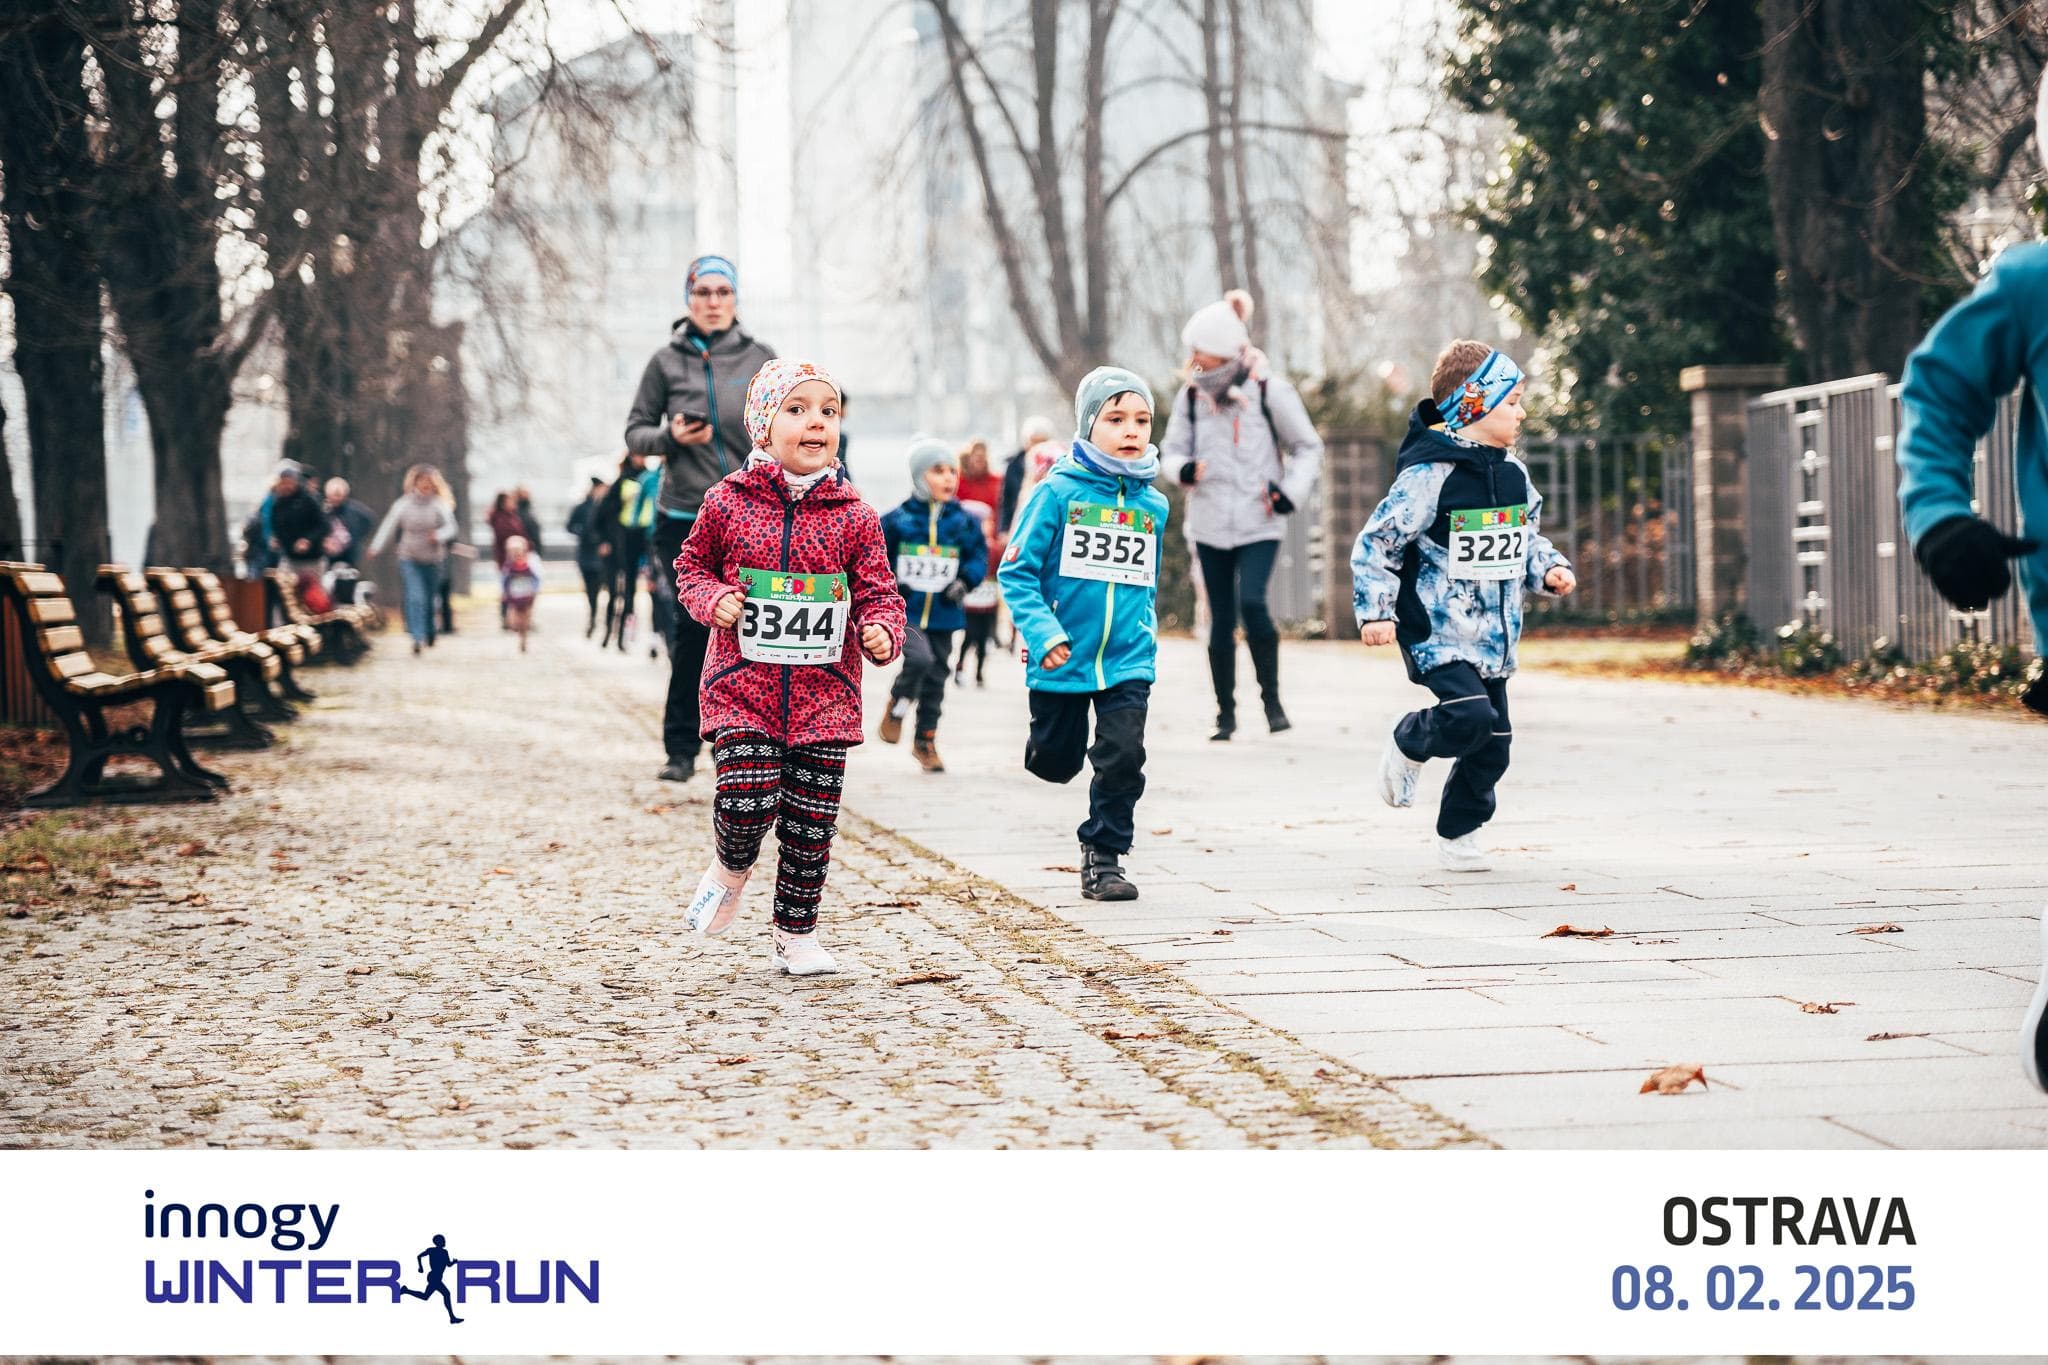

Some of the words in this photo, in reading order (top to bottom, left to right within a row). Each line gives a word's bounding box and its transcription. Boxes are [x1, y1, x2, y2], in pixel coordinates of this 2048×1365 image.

[1071, 530, 1146, 566] 3352
[1458, 532, 1522, 562] 3222
[771, 576, 815, 595] KIDS
[742, 602, 834, 641] 3344
[693, 888, 715, 915] 3344
